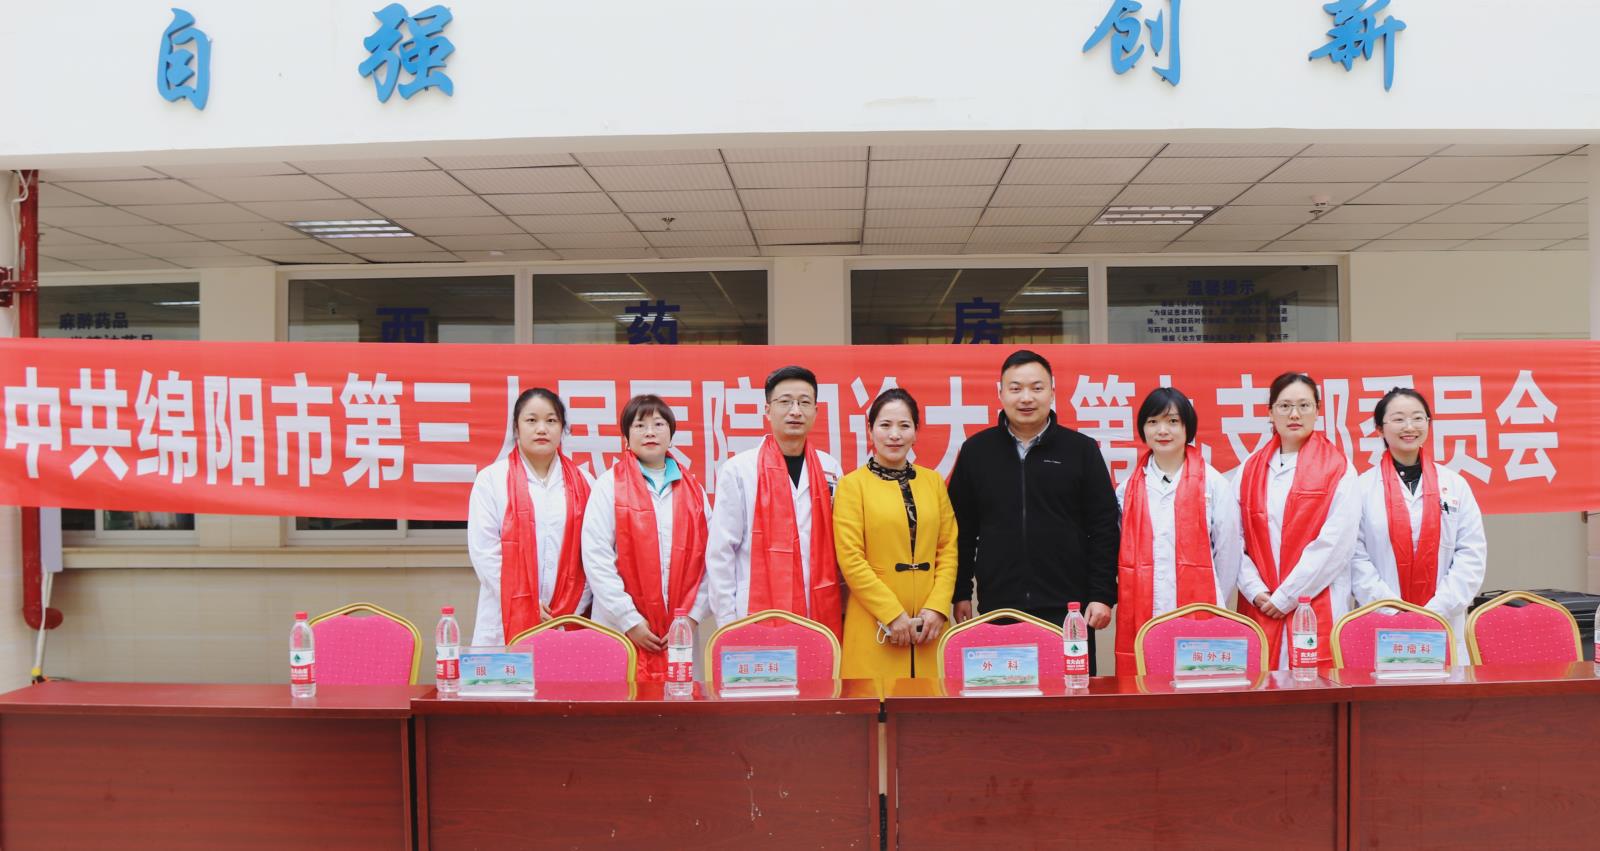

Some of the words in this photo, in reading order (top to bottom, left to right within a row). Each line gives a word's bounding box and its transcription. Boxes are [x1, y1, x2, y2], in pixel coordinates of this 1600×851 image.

[59, 312, 128, 329] 麻醉药品
[1392, 643, 1432, 655] 肿瘤科
[1192, 651, 1232, 663] 胸外科
[475, 664, 517, 677] 眼科
[737, 662, 779, 675] 超声科
[982, 659, 1019, 671] 外科
